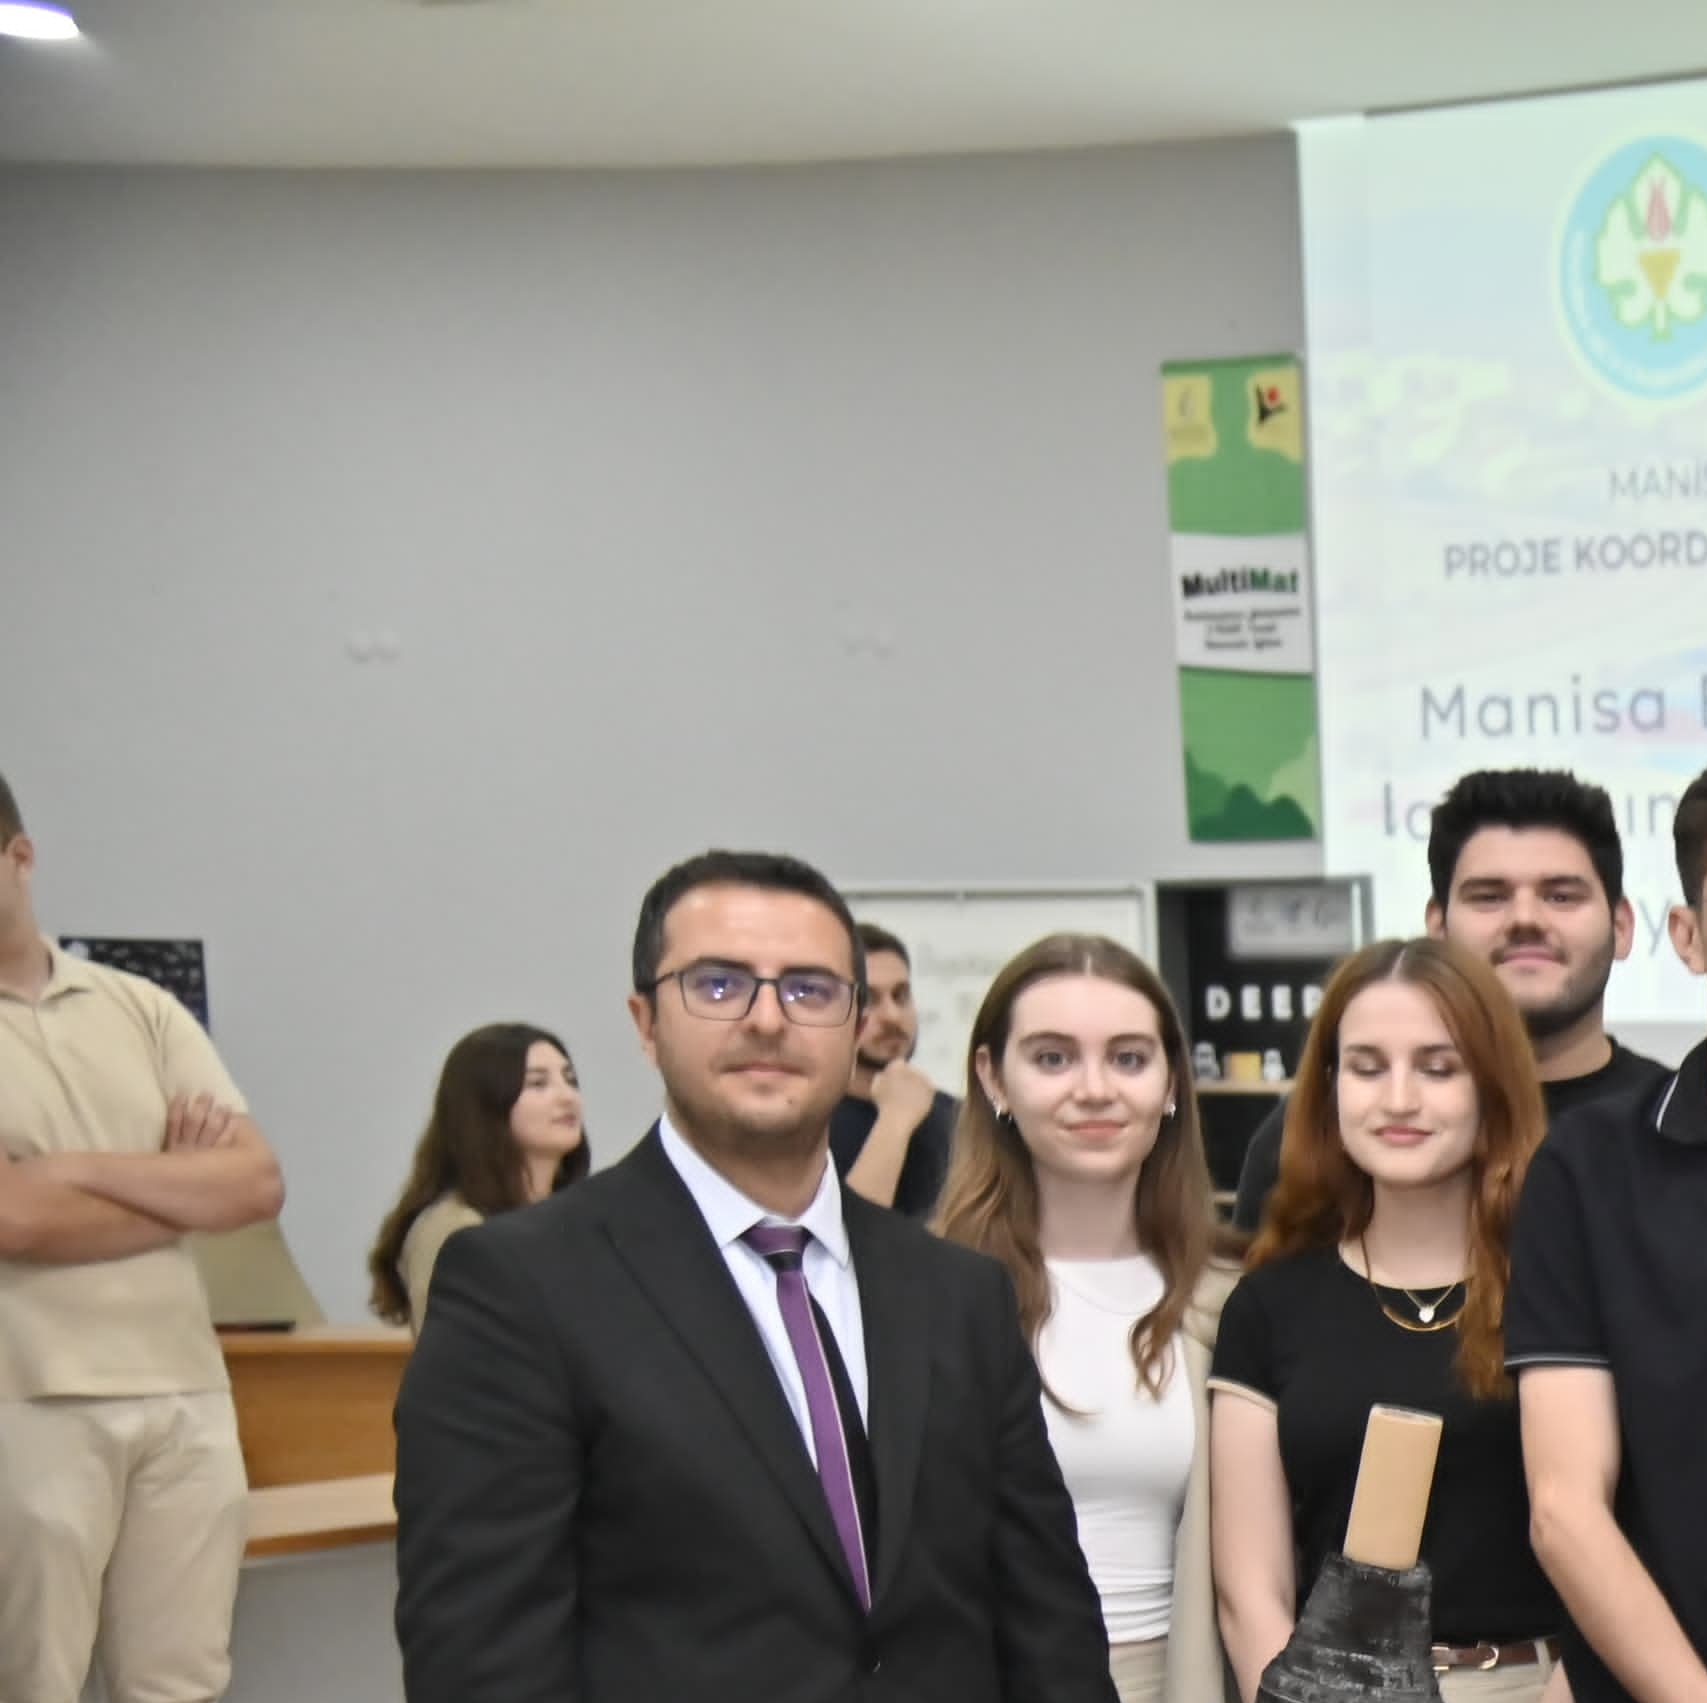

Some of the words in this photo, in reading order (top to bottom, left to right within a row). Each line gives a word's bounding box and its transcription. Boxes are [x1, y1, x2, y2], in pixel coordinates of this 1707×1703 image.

[1443, 538, 1562, 580] PROJE
[1182, 567, 1299, 599] MultiMat
[1419, 673, 1667, 740] Manisa
